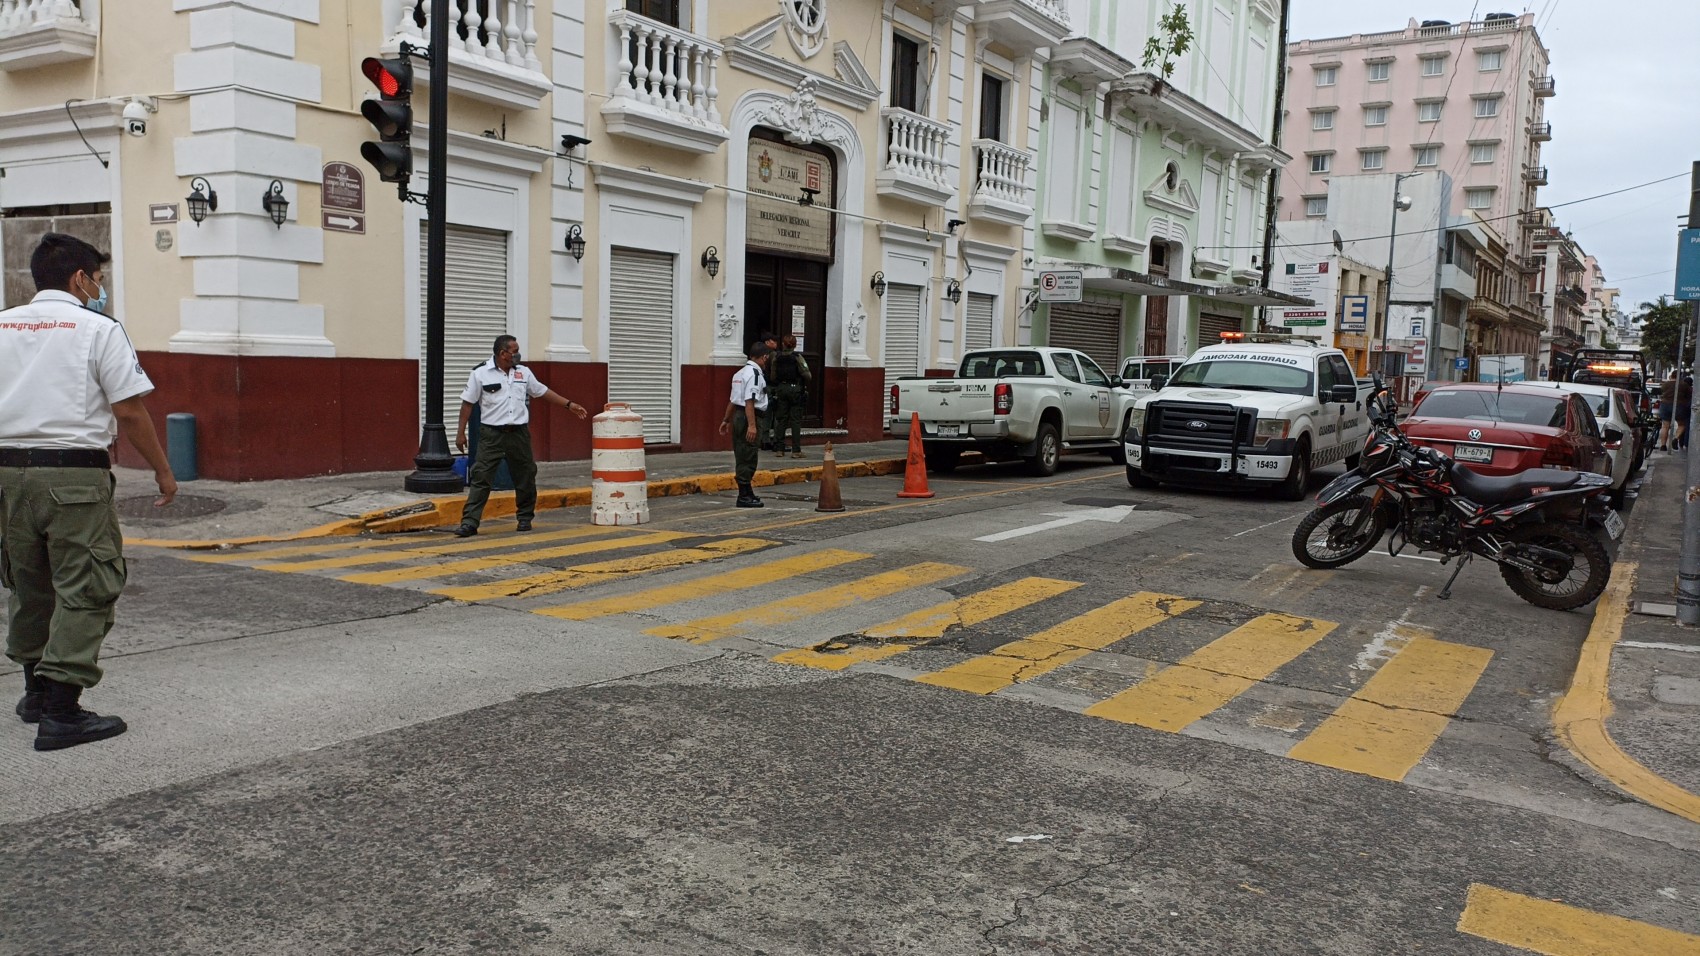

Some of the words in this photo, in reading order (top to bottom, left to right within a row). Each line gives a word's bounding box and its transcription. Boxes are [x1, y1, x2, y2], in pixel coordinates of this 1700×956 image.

[777, 228, 801, 239] VERACRUZ
[1344, 297, 1366, 322] E
[1127, 448, 1140, 458] 15493
[1256, 460, 1278, 470] 15493
